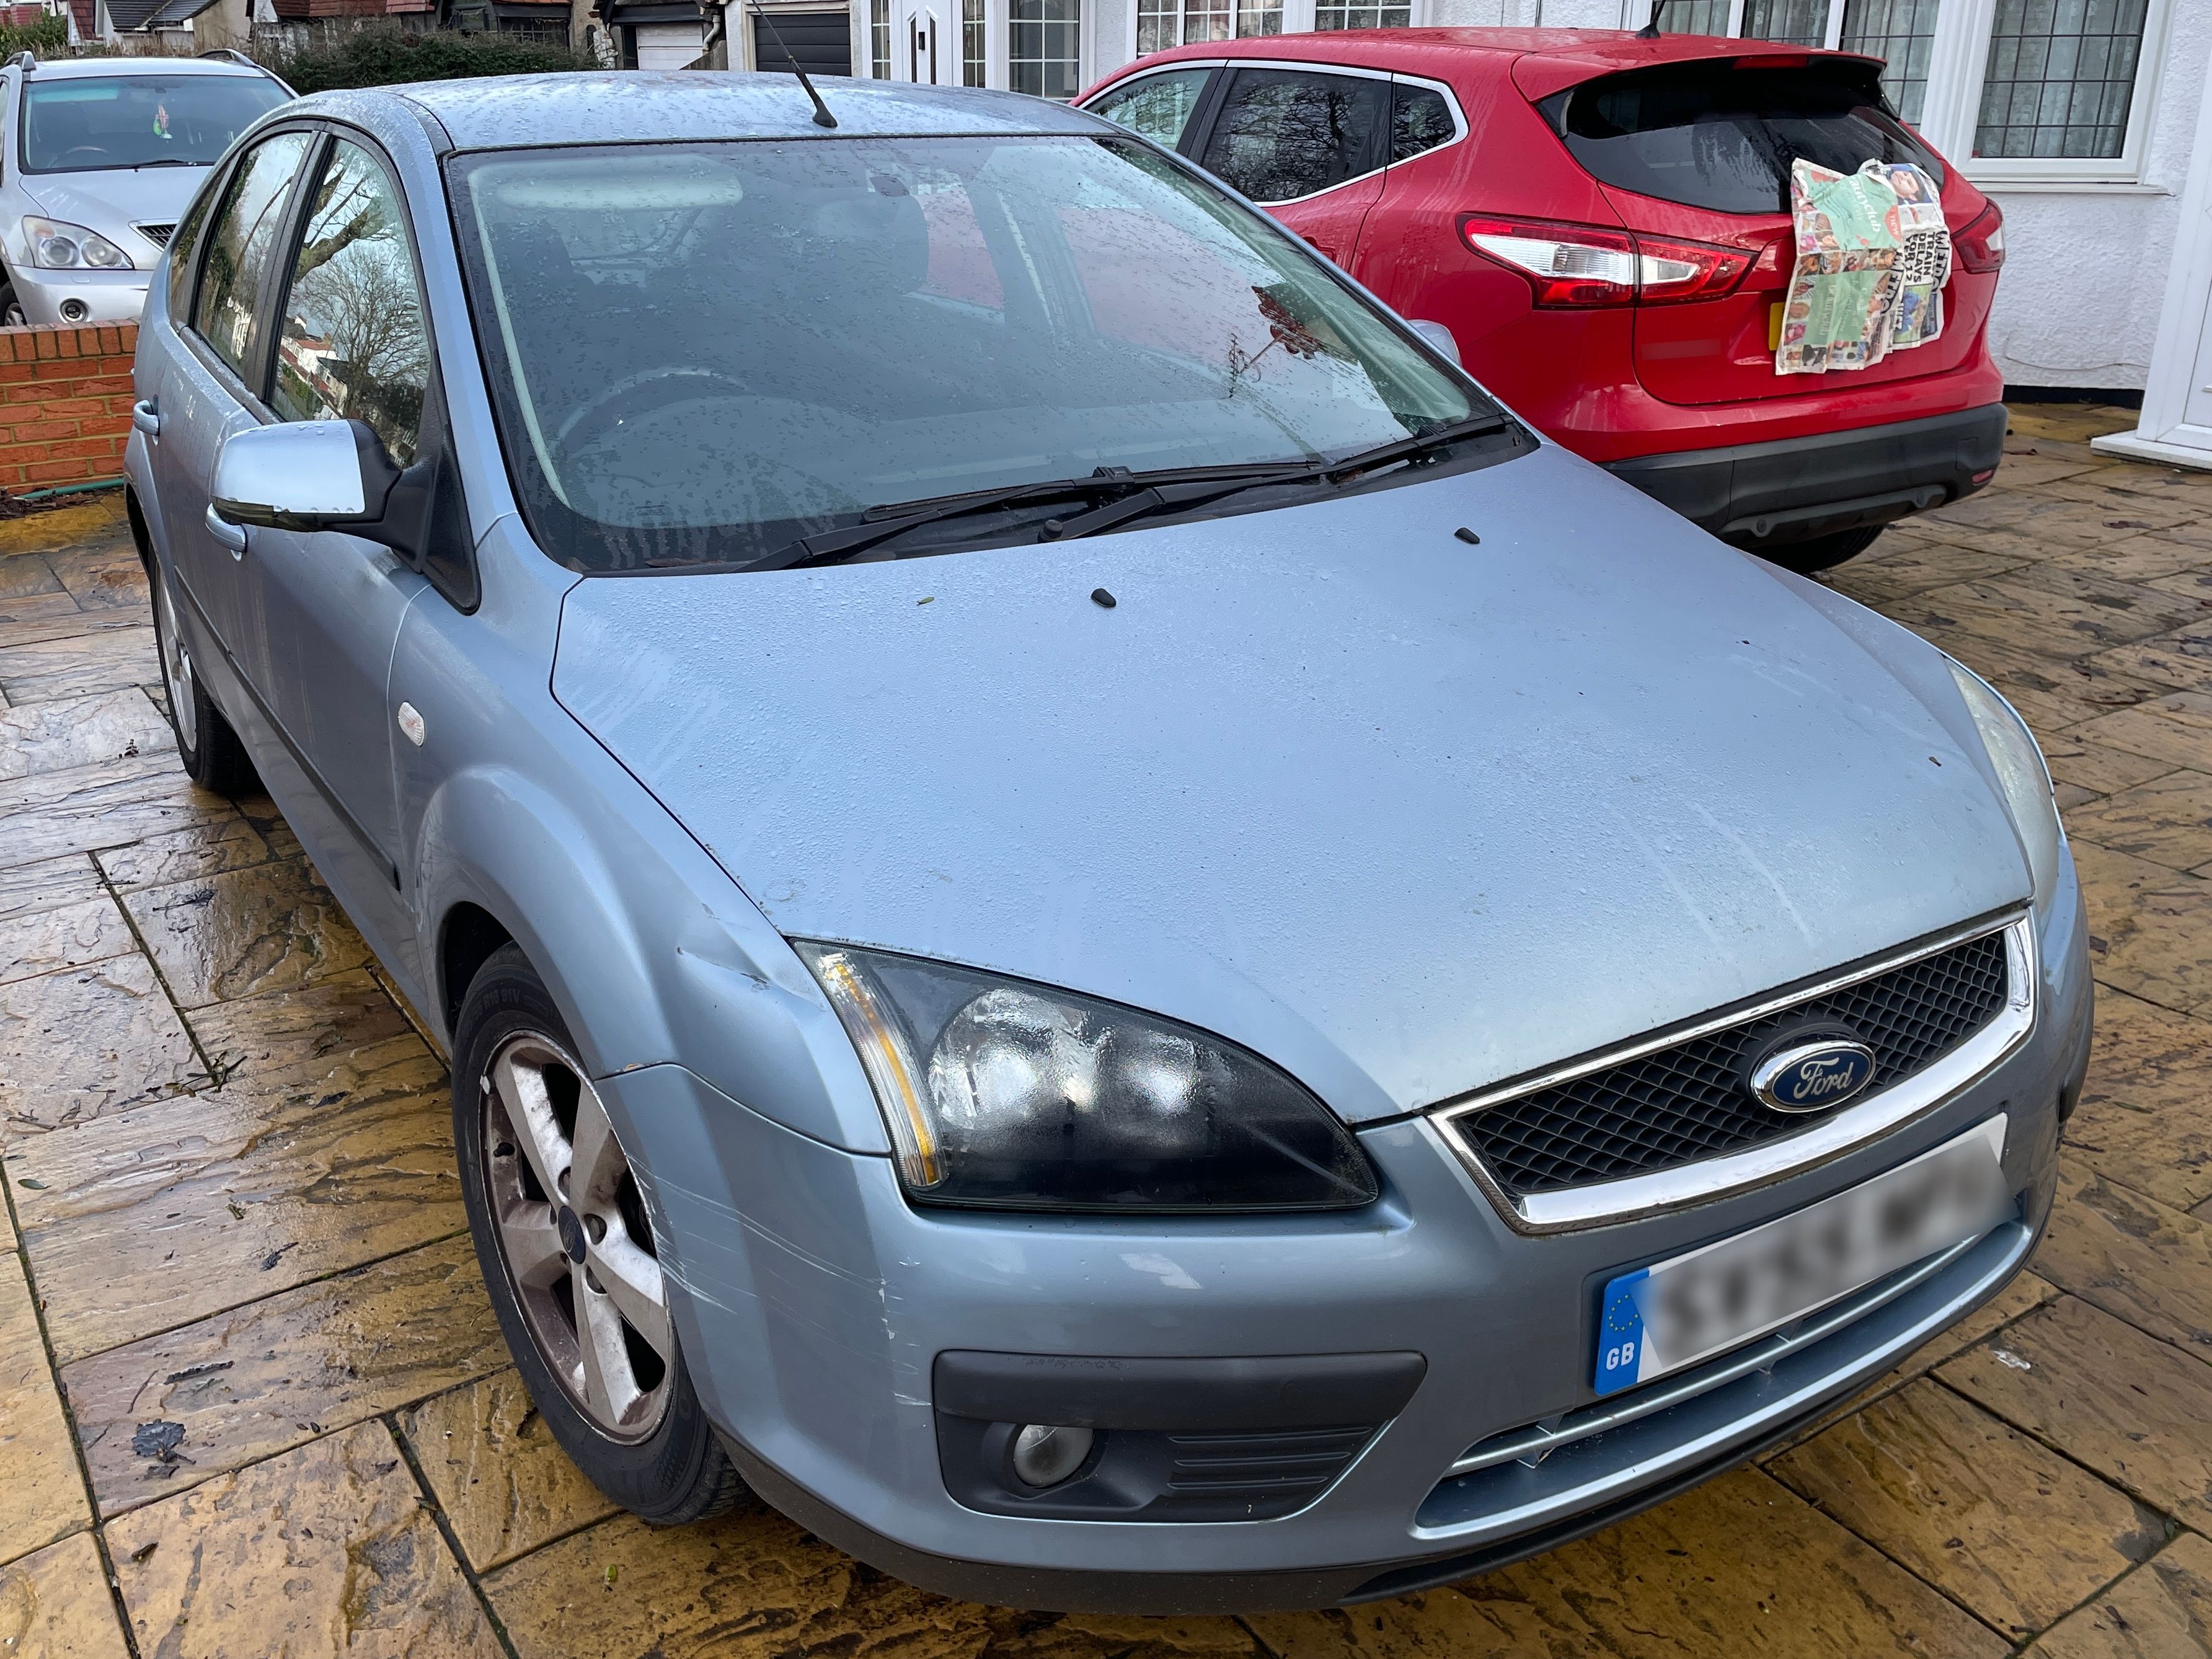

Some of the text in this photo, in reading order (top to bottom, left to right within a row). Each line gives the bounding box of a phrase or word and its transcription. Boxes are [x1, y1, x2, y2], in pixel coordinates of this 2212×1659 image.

[1889, 215, 1899, 234] new
[1905, 234, 1919, 281] FOR 12
[1913, 232, 1927, 283] DELAYS
[1923, 231, 1935, 276] TRAIN
[1794, 1057, 1854, 1099] Ford
[1606, 1342, 1635, 1370] GB
